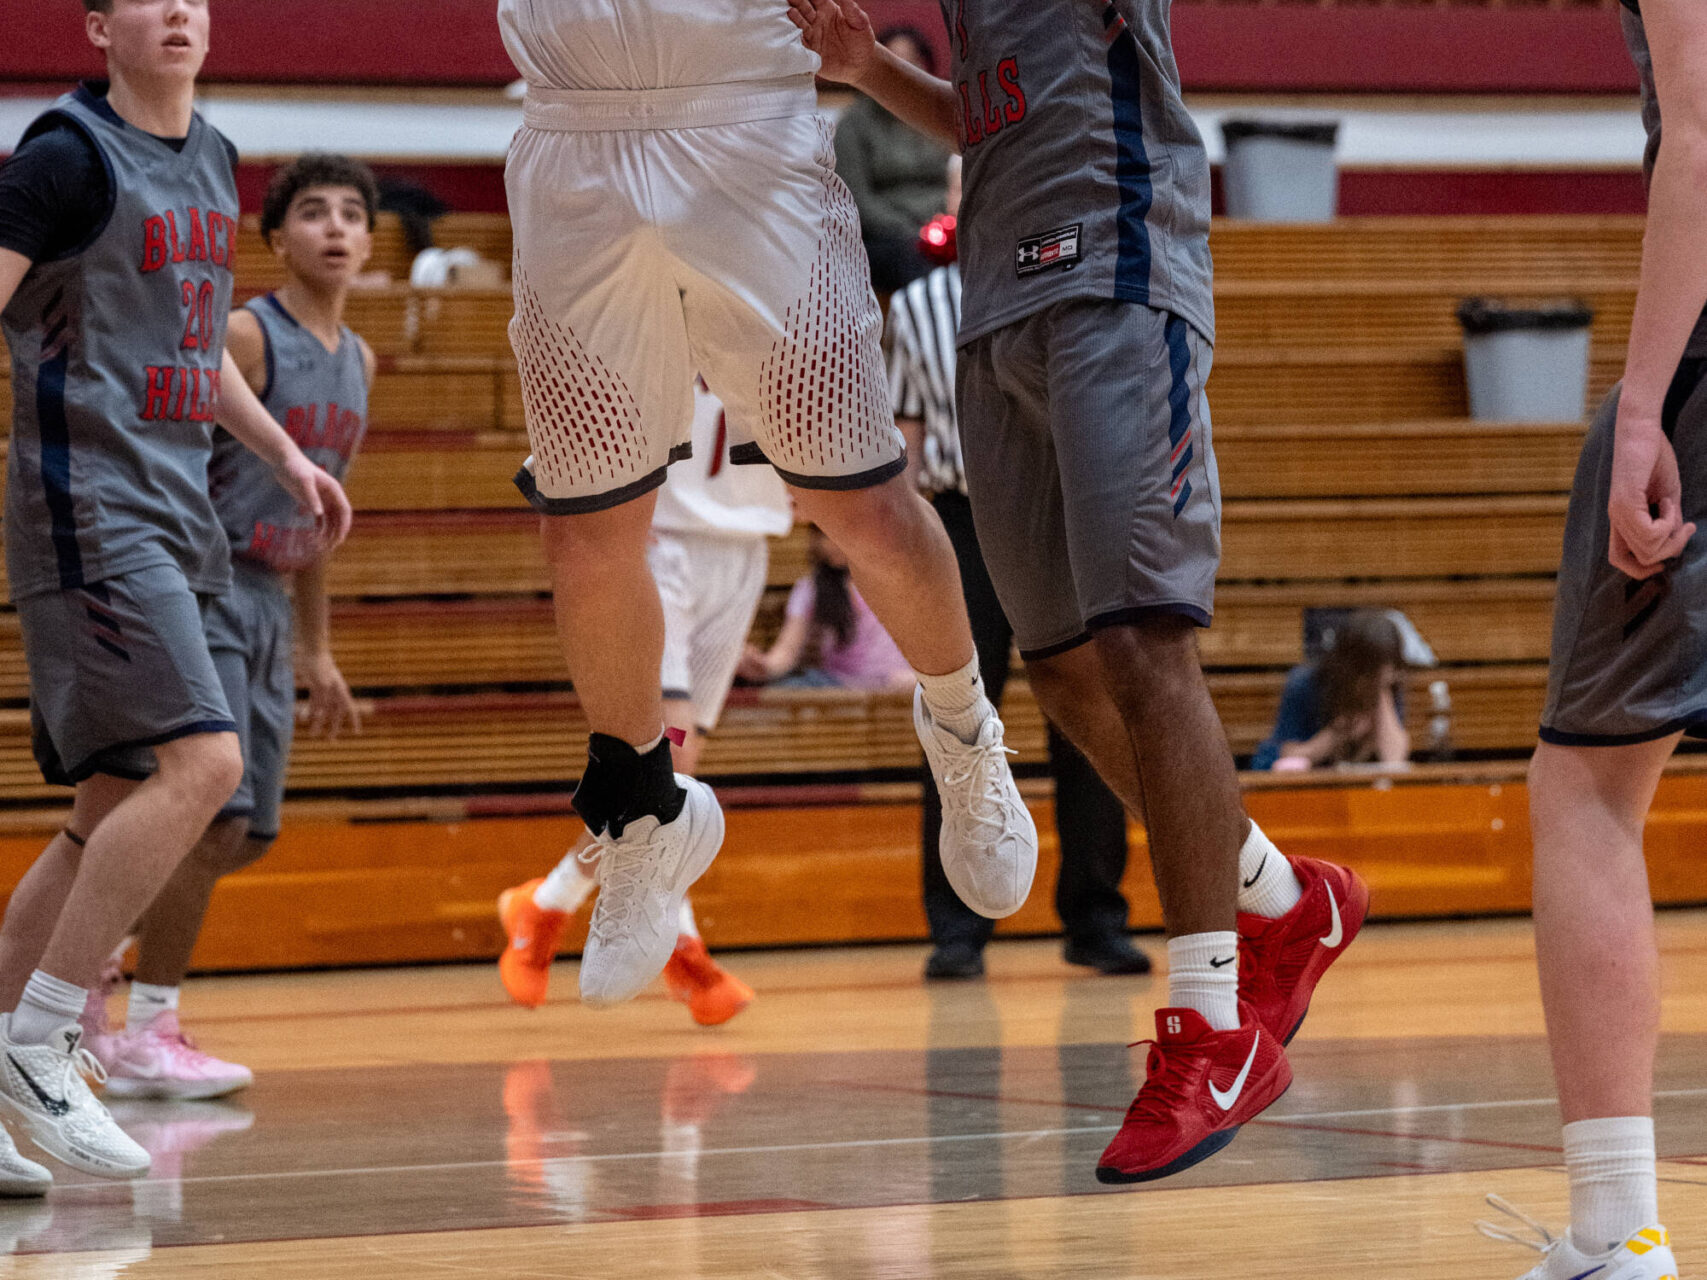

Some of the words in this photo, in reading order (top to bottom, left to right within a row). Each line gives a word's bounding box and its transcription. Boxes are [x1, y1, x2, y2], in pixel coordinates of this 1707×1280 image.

[959, 56, 1026, 149] LLS
[180, 279, 214, 352] 20
[140, 366, 221, 421] HIL
